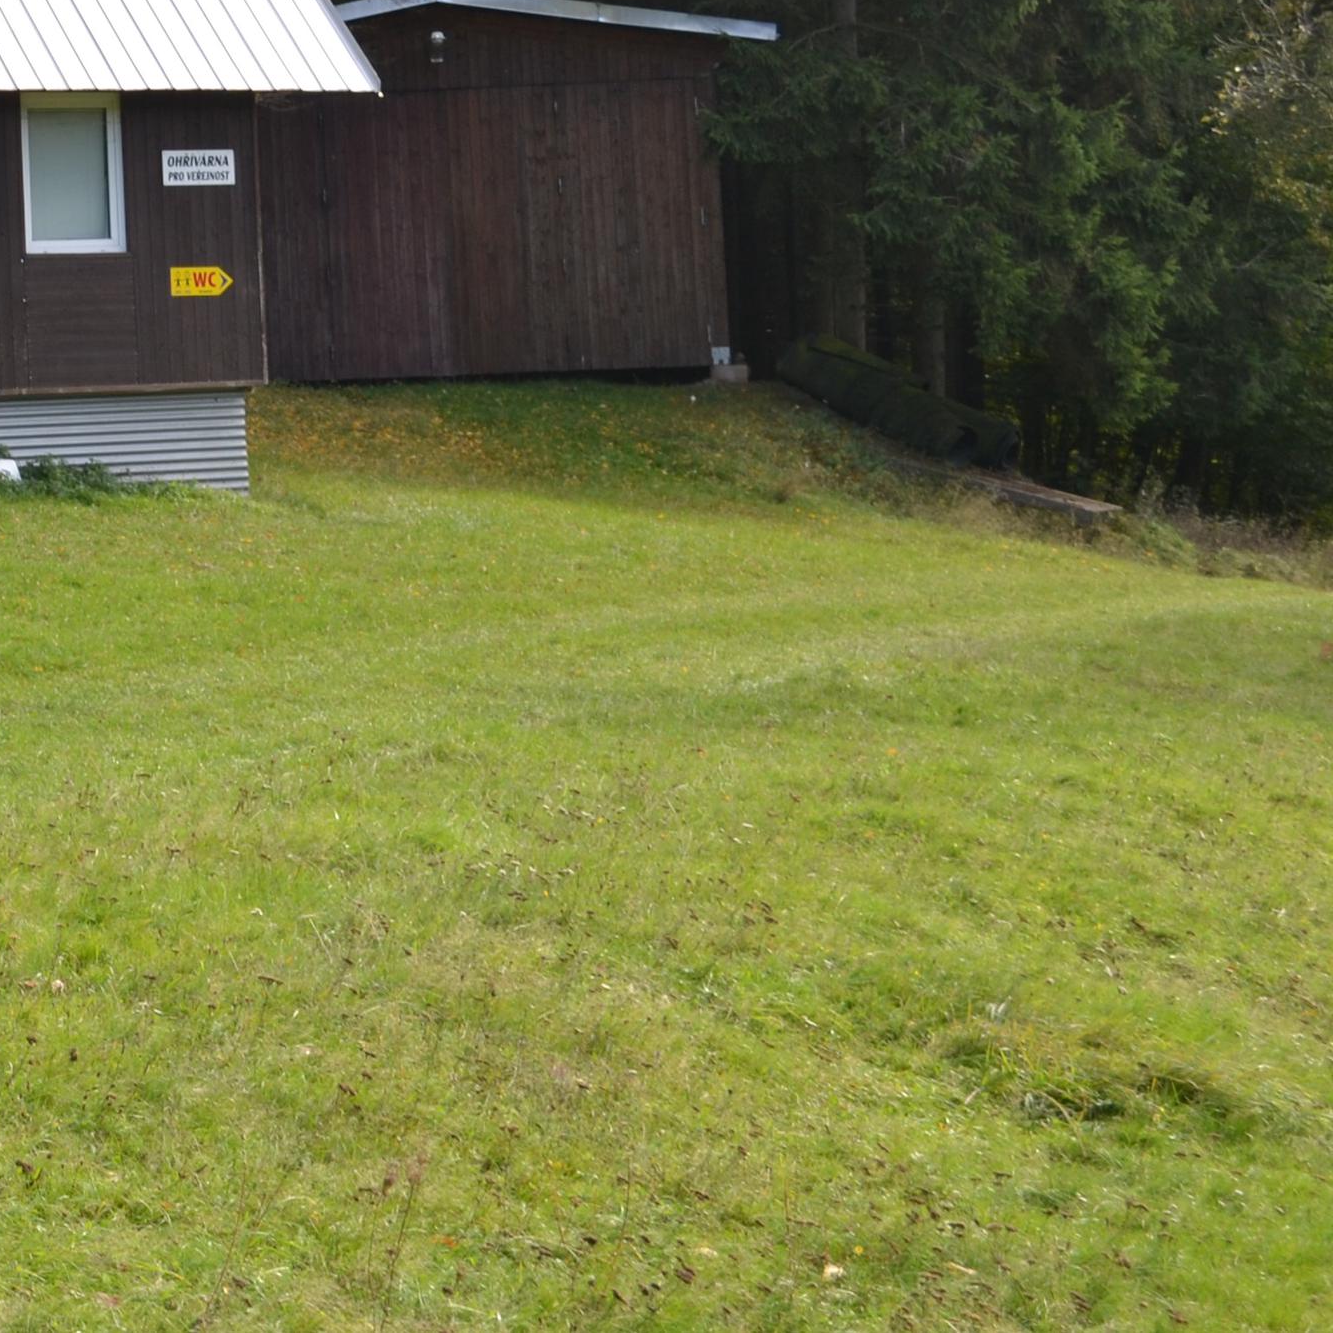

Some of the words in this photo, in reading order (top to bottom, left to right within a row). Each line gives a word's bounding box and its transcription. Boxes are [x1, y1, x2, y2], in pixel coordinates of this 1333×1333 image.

[168, 171, 185, 182] PRO
[186, 169, 230, 181] VEŘEJNOST
[193, 271, 217, 288] WC
